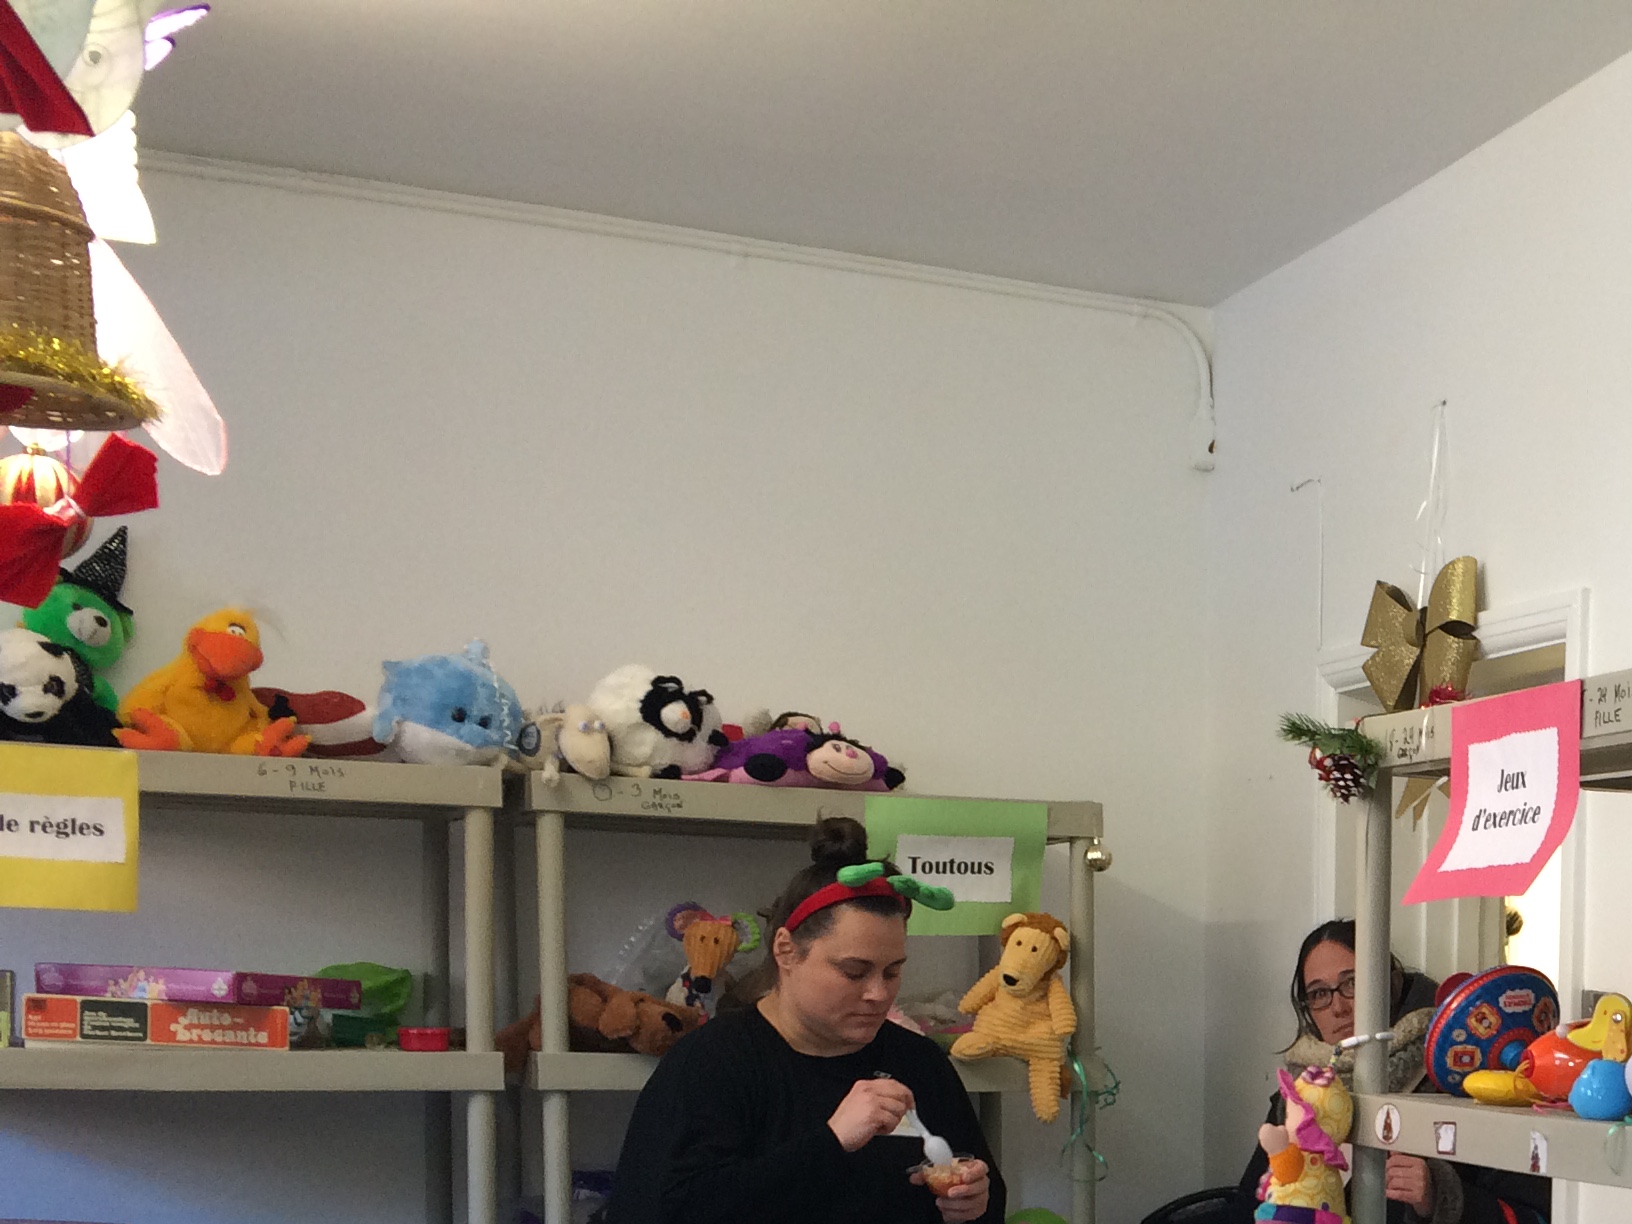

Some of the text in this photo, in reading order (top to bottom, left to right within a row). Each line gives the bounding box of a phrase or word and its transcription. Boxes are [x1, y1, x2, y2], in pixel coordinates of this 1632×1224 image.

[1594, 708, 1622, 728] FILLE
[257, 763, 268, 777] 6
[285, 764, 297, 777] 9
[631, 783, 642, 797] 3
[1497, 768, 1527, 793] Jeux
[29, 815, 105, 839] règles
[1471, 802, 1541, 832] d'exercice
[907, 856, 995, 876] Toutous
